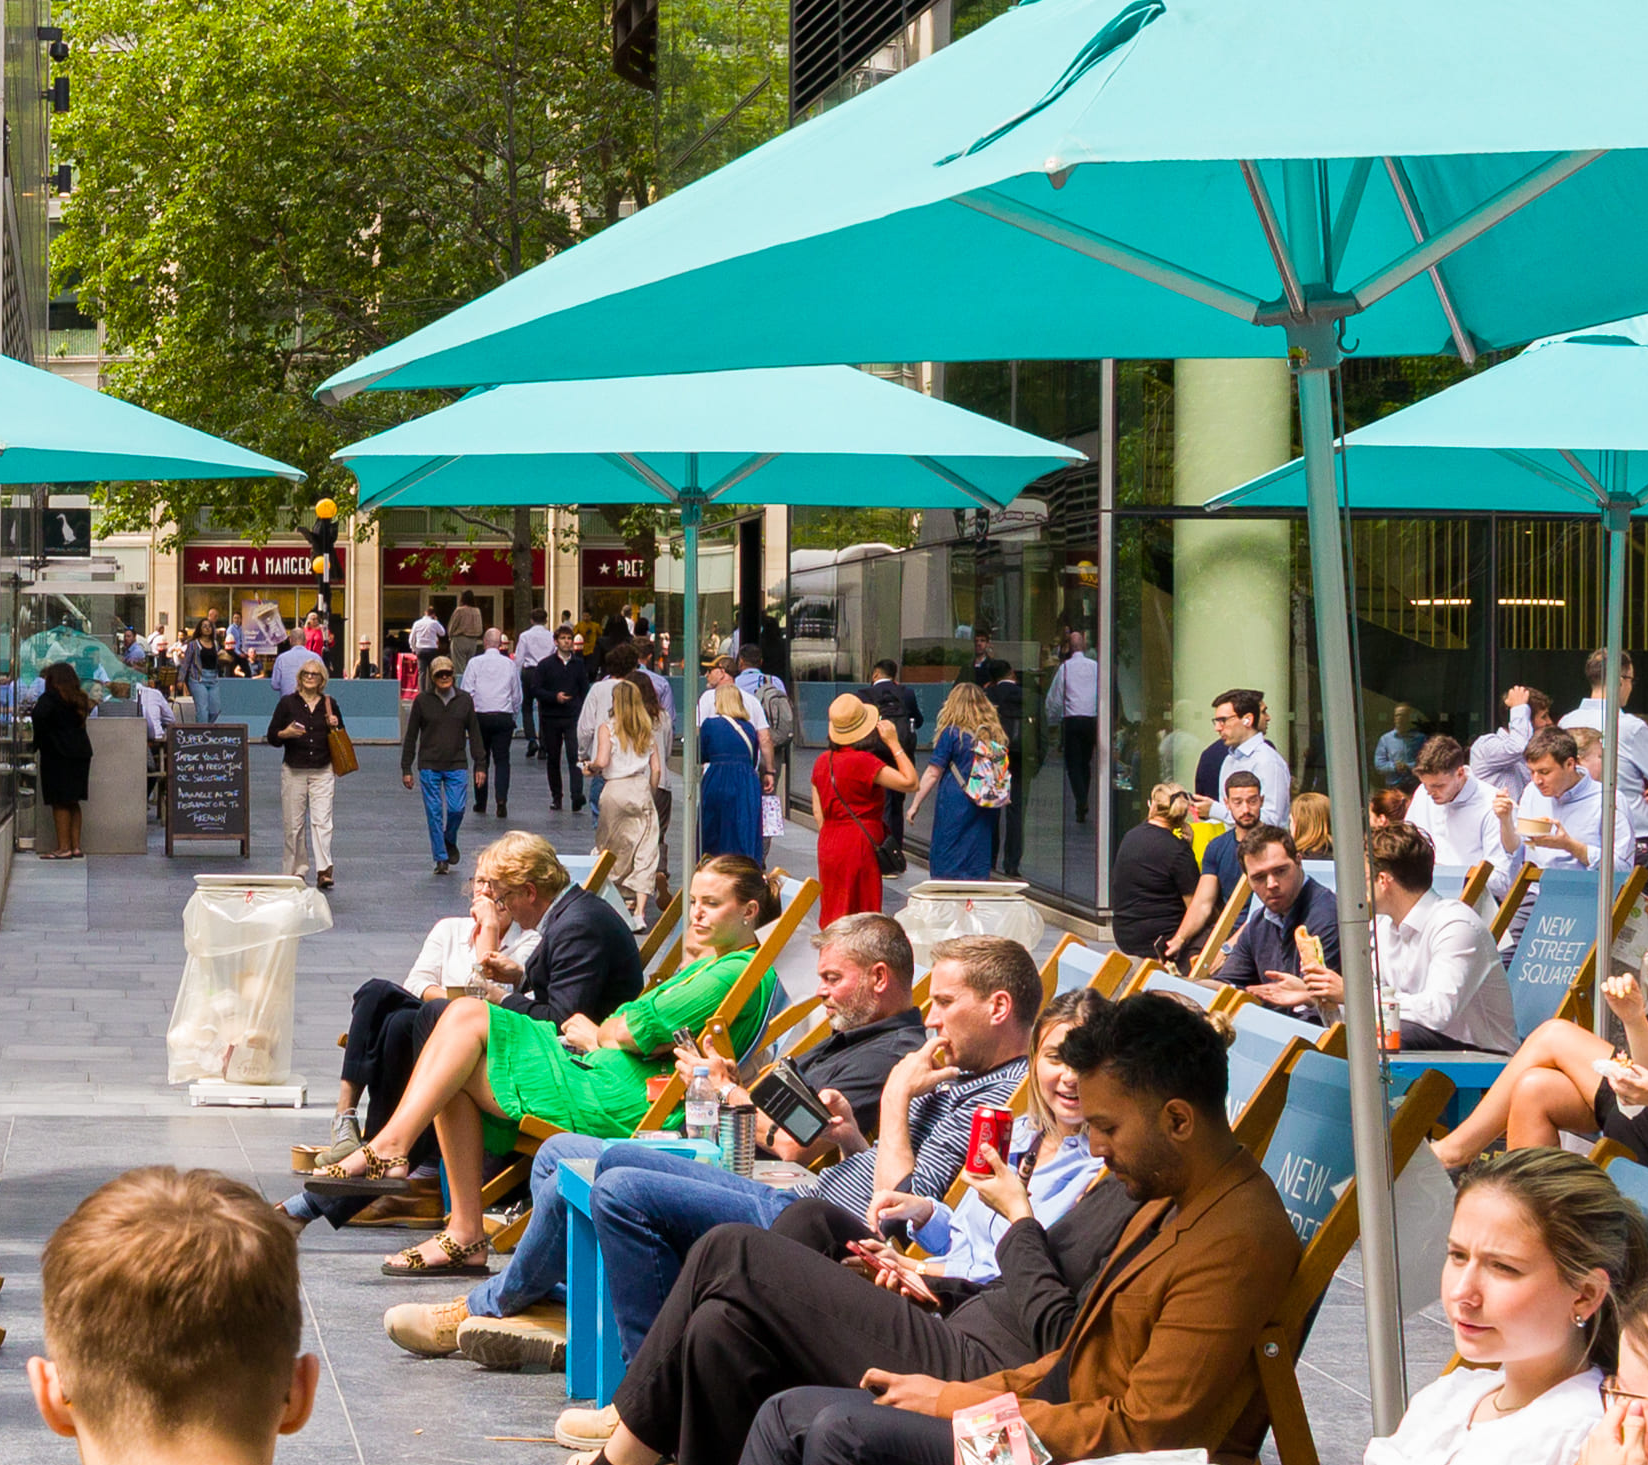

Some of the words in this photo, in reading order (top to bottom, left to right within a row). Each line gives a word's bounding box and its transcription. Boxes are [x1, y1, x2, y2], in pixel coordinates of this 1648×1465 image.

[216, 556, 245, 575] PRET
[251, 556, 259, 575] A
[265, 556, 313, 575] MANGER
[617, 559, 645, 577] PRET
[1536, 915, 1577, 937] NEW
[1527, 938, 1586, 962] STREET
[1518, 961, 1581, 985] SQUARE
[1275, 1151, 1332, 1206] NEW
